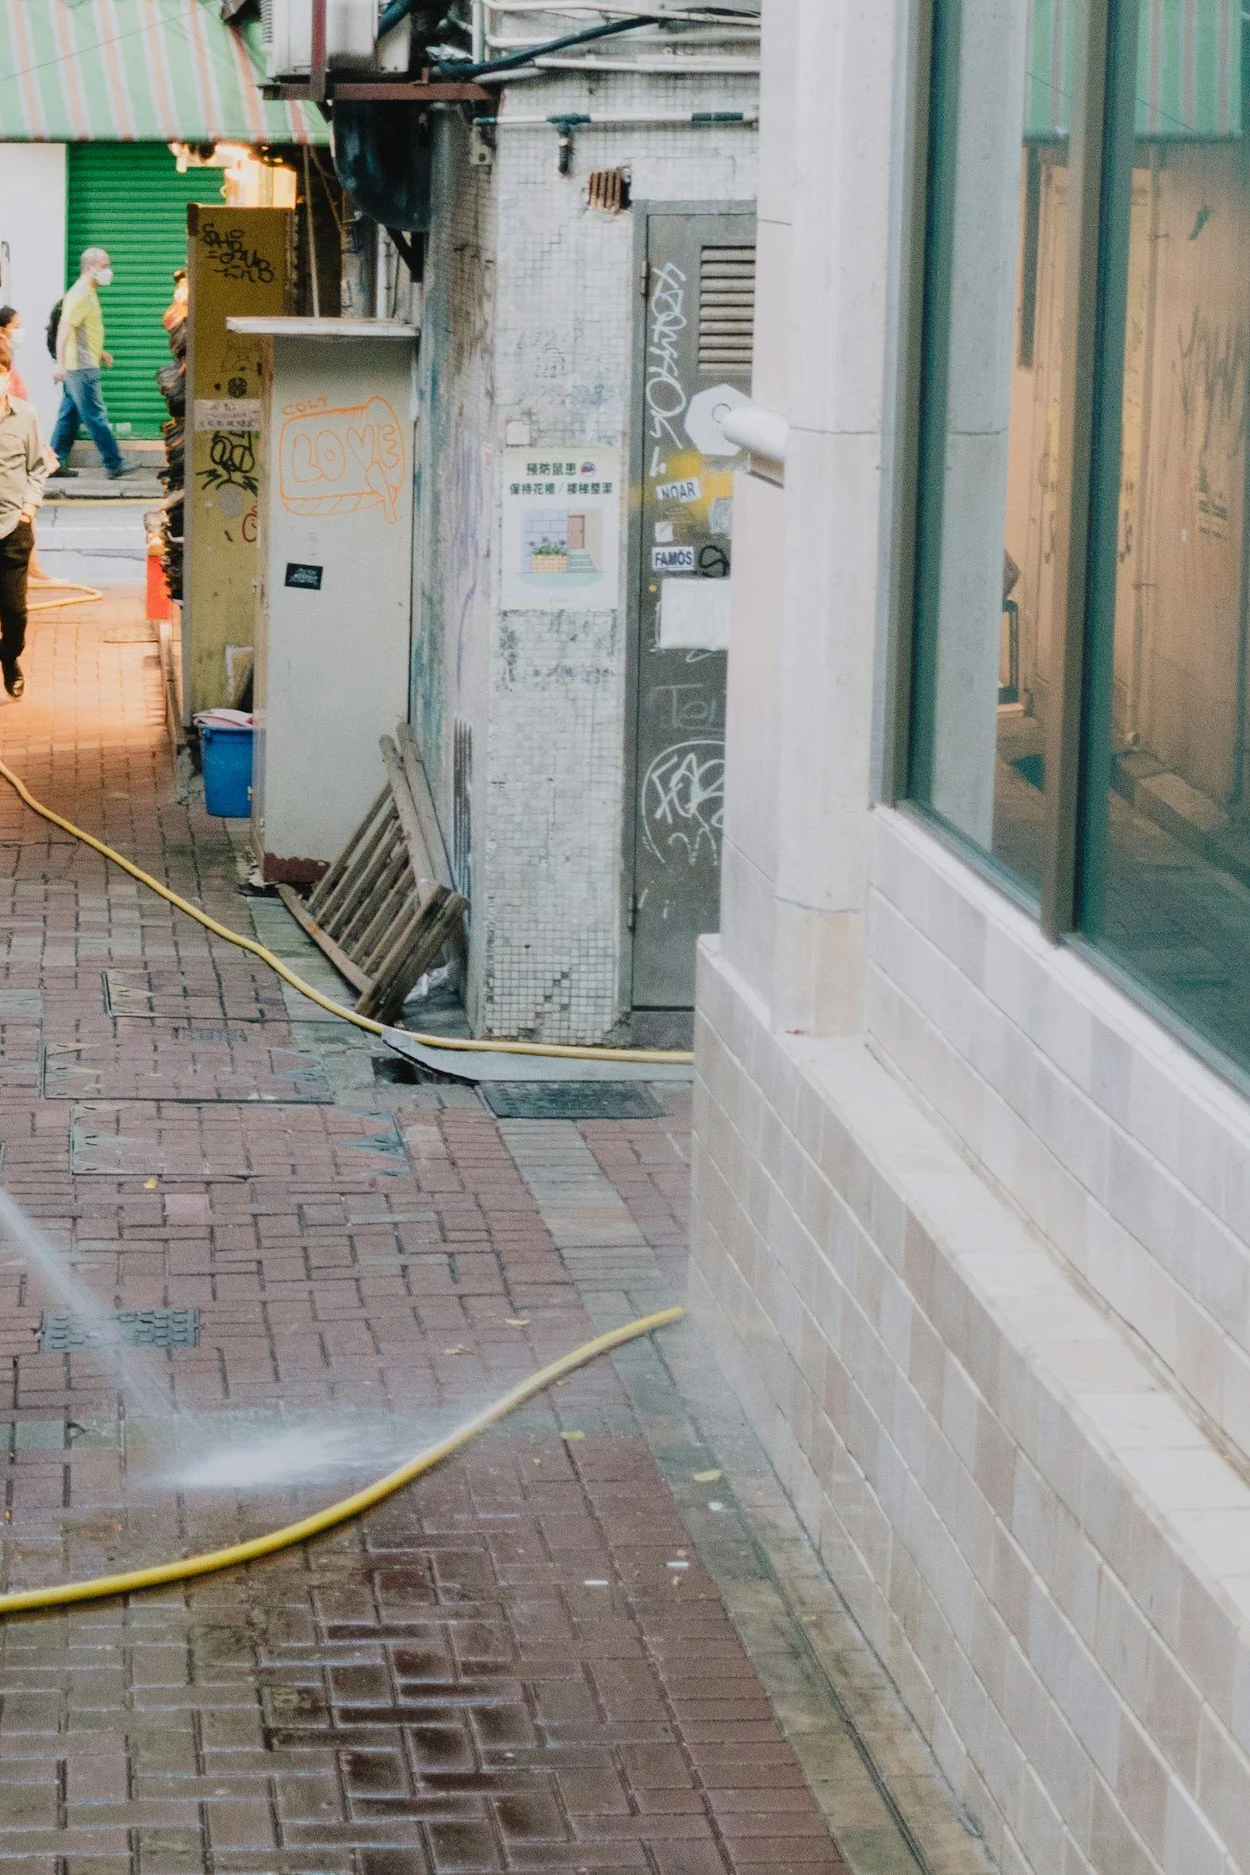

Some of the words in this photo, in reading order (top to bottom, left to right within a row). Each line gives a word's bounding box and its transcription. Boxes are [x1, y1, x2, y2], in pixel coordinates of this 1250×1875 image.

[291, 423, 400, 483] LOVE
[526, 462, 577, 476] 預防鼠患
